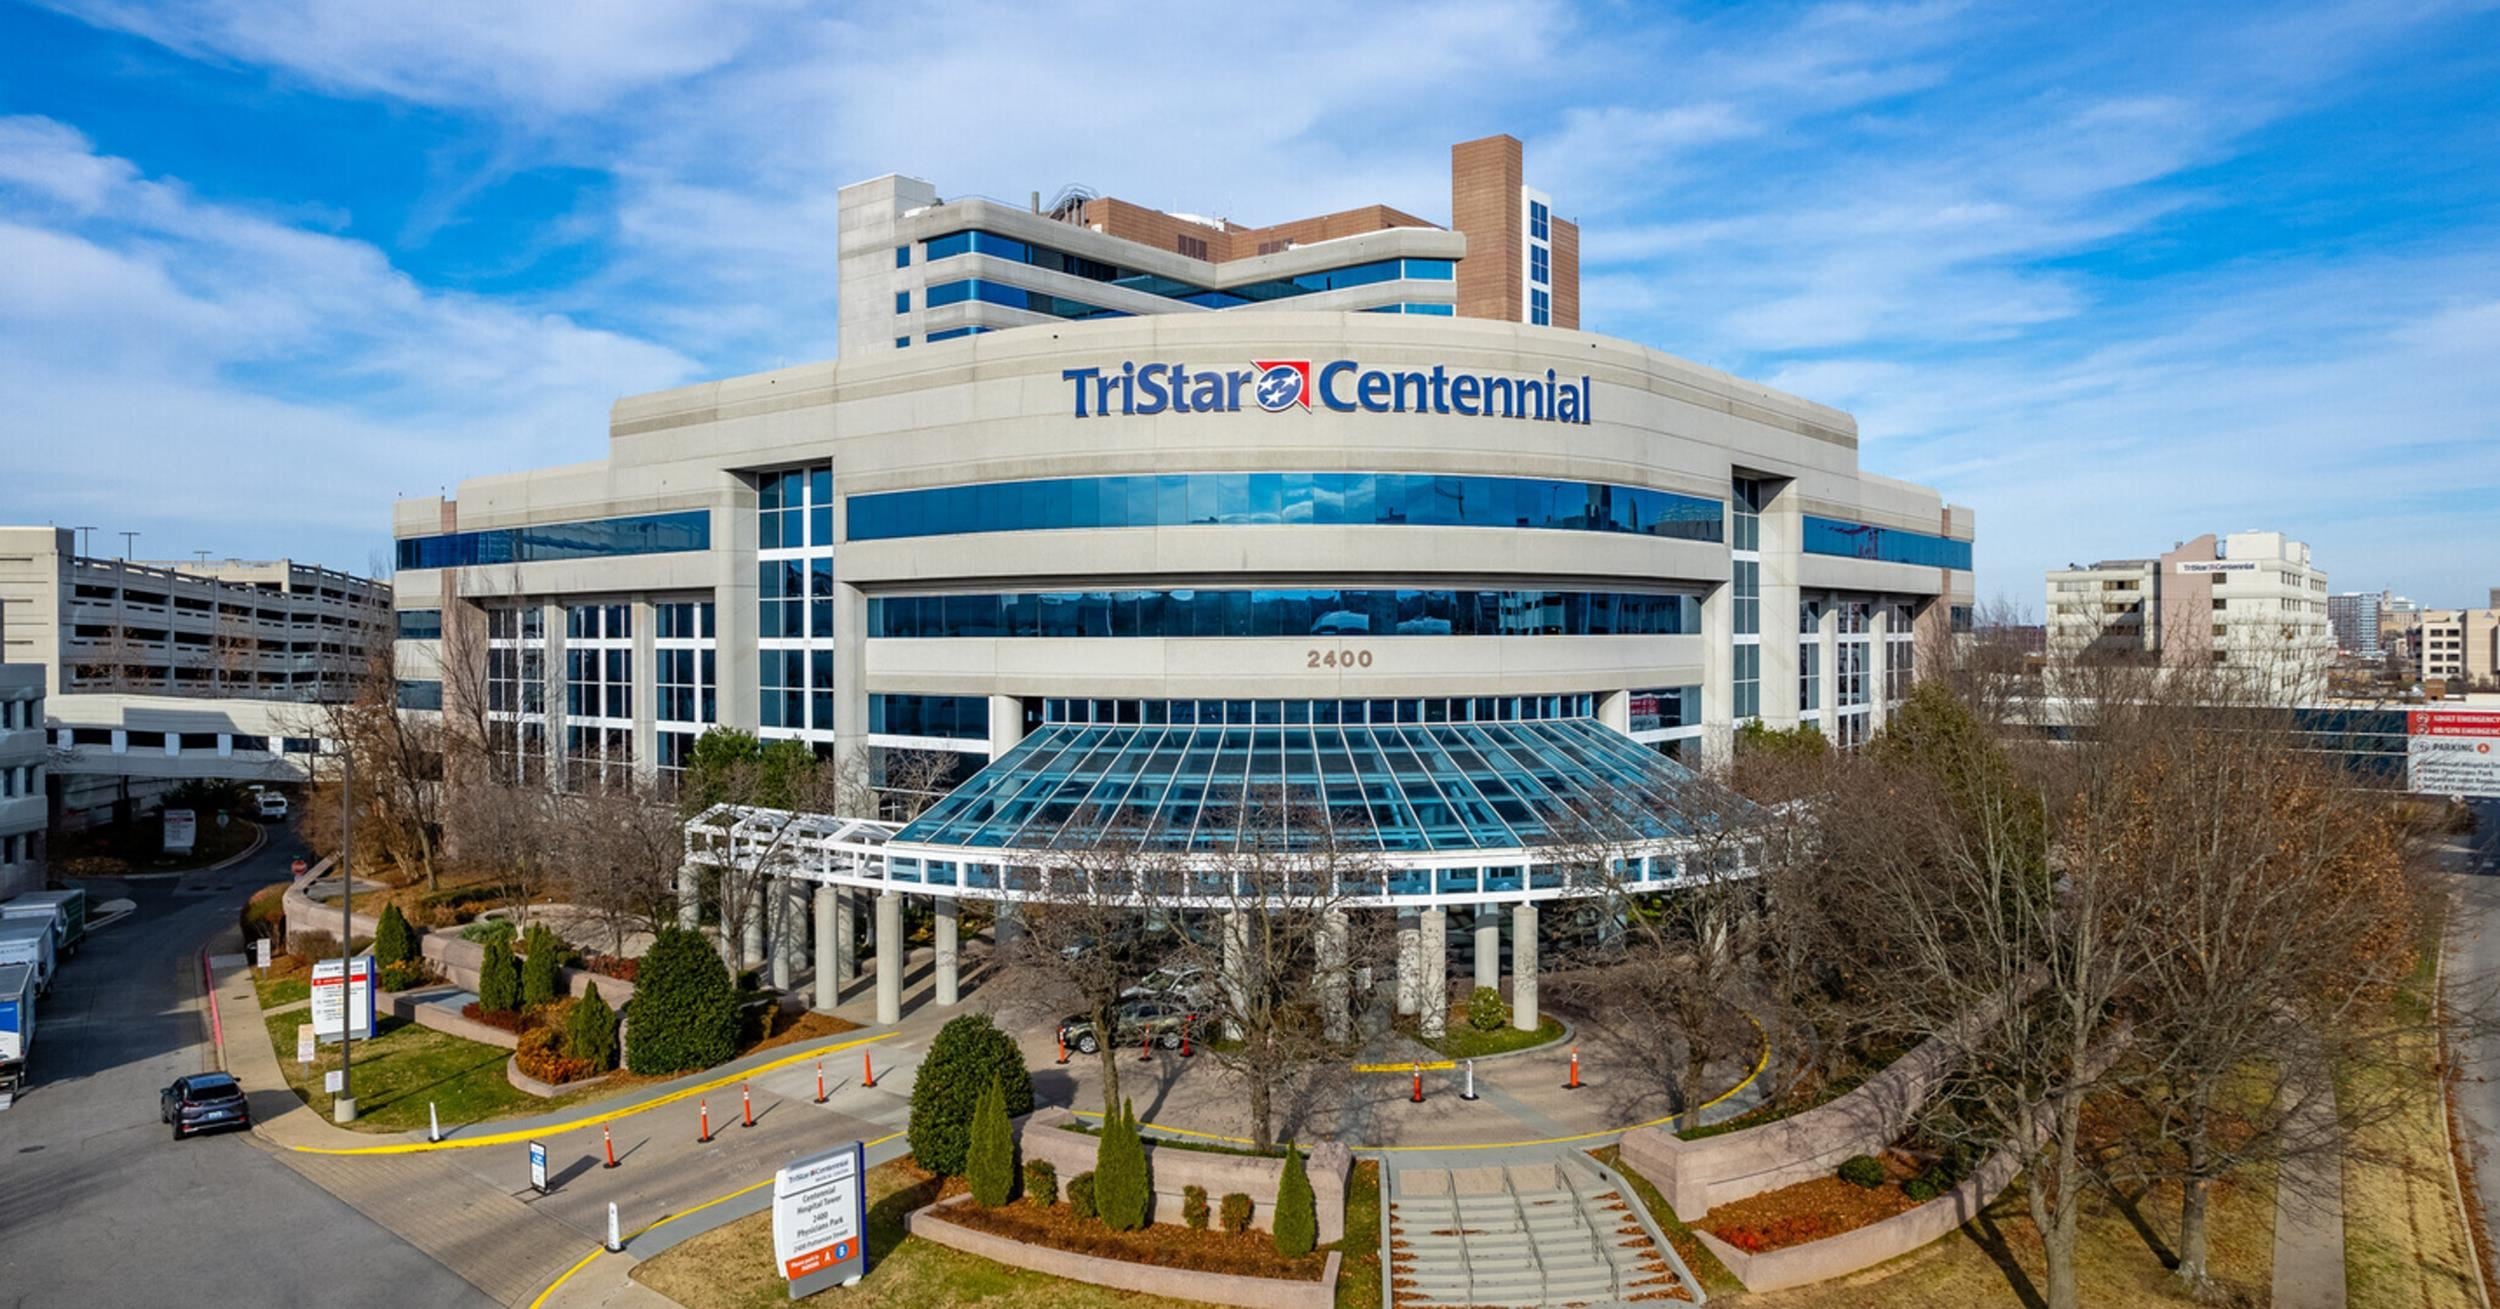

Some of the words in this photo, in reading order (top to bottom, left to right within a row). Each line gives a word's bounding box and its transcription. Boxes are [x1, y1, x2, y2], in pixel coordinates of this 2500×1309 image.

[1062, 361, 1254, 418] TriStar
[1318, 360, 1591, 425] Centennial
[1307, 650, 1373, 668] 2400
[2432, 743, 2474, 752] PARKING
[2478, 769, 2494, 777] Park
[788, 1172, 809, 1183] TriStar
[815, 1159, 849, 1175] Centennial
[802, 1186, 836, 1203] Centennial
[797, 1200, 823, 1215] Hospital
[823, 1194, 842, 1206] Tower
[813, 1211, 828, 1223] 2400
[797, 1223, 829, 1238] Physicians
[829, 1216, 843, 1227] Park
[824, 1251, 831, 1263] A
